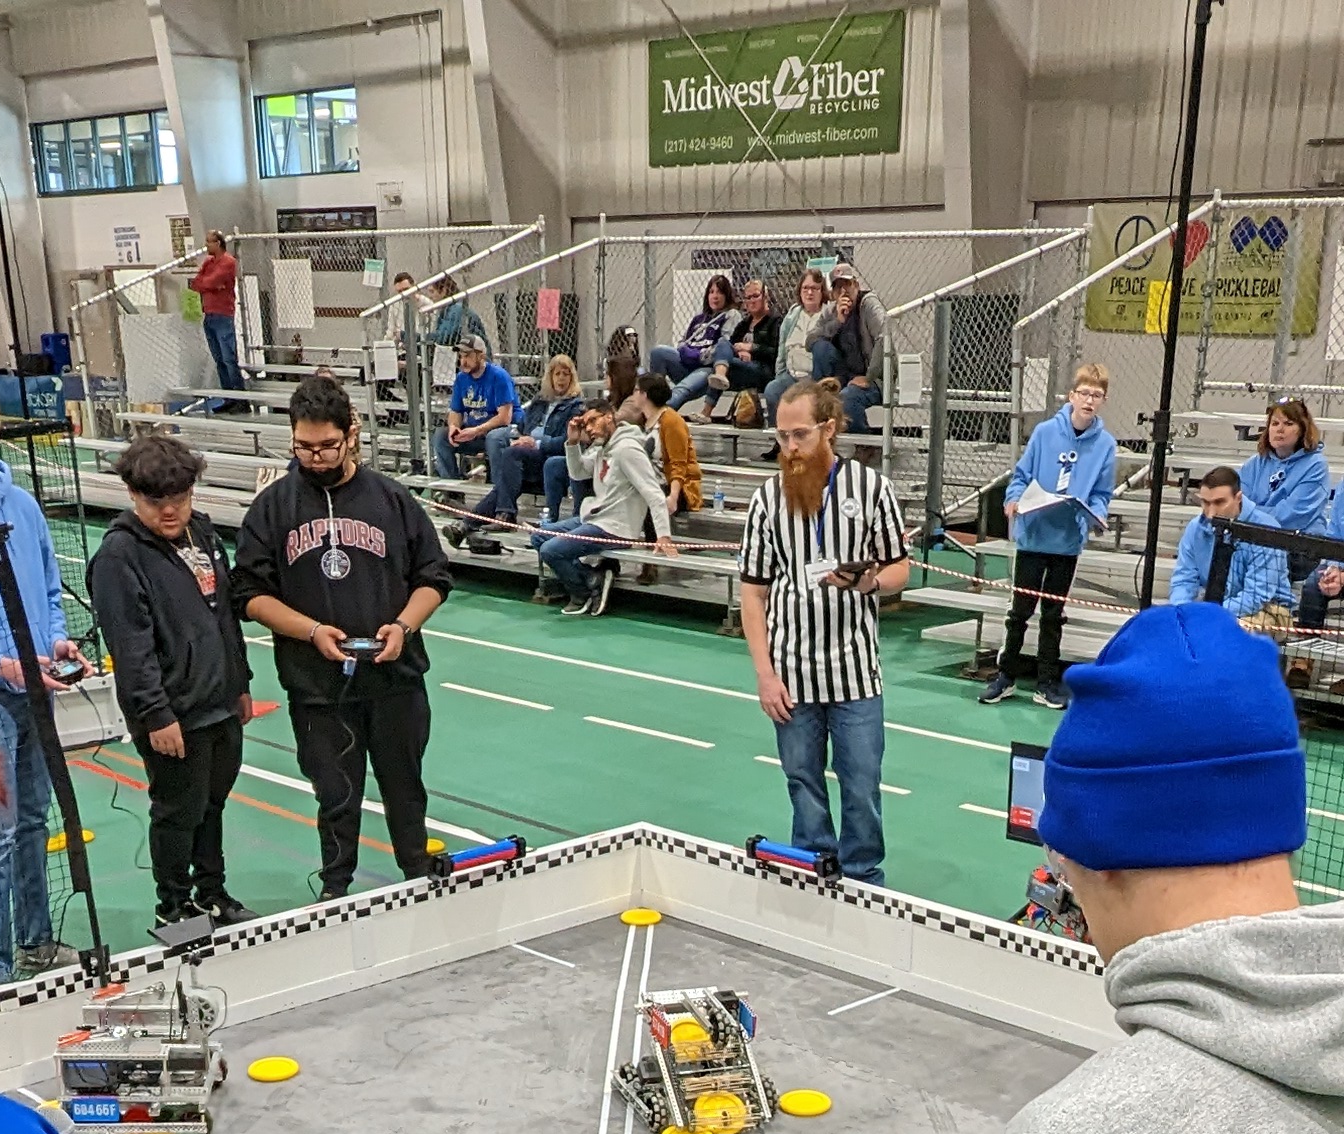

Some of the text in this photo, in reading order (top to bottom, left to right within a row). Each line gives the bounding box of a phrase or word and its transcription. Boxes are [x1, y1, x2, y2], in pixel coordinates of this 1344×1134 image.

[662, 61, 885, 113] Midwest Fiber
[809, 98, 880, 115] RECYCLING
[664, 140, 687, 153] (217)
[689, 135, 733, 151] 424-9460
[1109, 276, 1147, 296] PEACE
[1215, 277, 1281, 299] PICKLEBAL
[286, 518, 386, 566] RAPTORS
